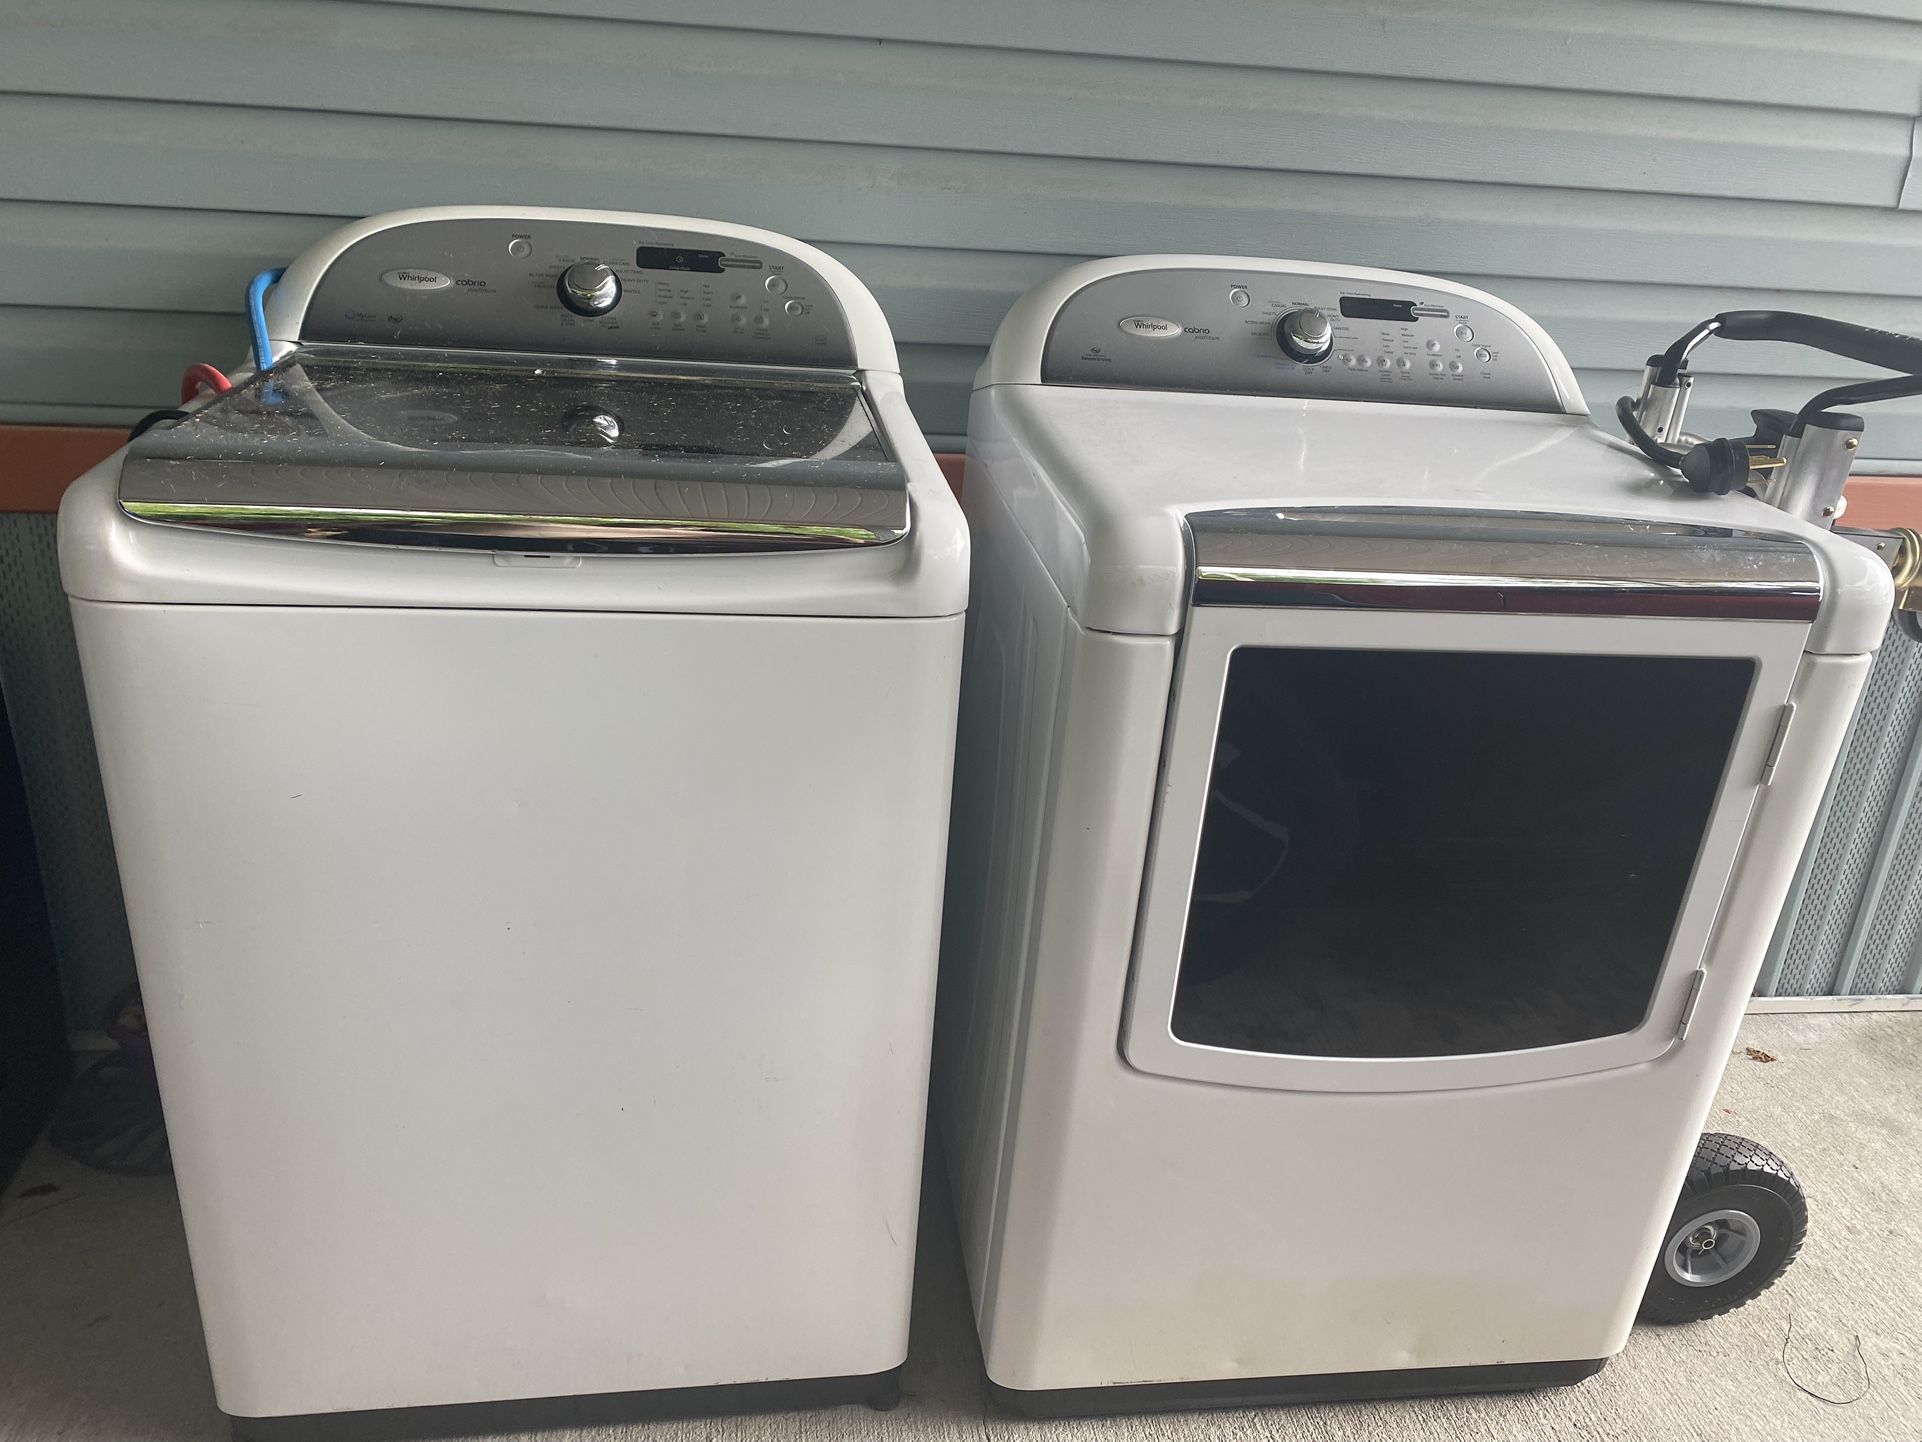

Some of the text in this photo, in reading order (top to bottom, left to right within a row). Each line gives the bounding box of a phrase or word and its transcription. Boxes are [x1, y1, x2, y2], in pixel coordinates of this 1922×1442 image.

[398, 273, 437, 283] Whirlpool
[455, 278, 487, 287] cabrio
[1133, 321, 1168, 331] Whirlpool
[1183, 326, 1211, 335] cabrio
